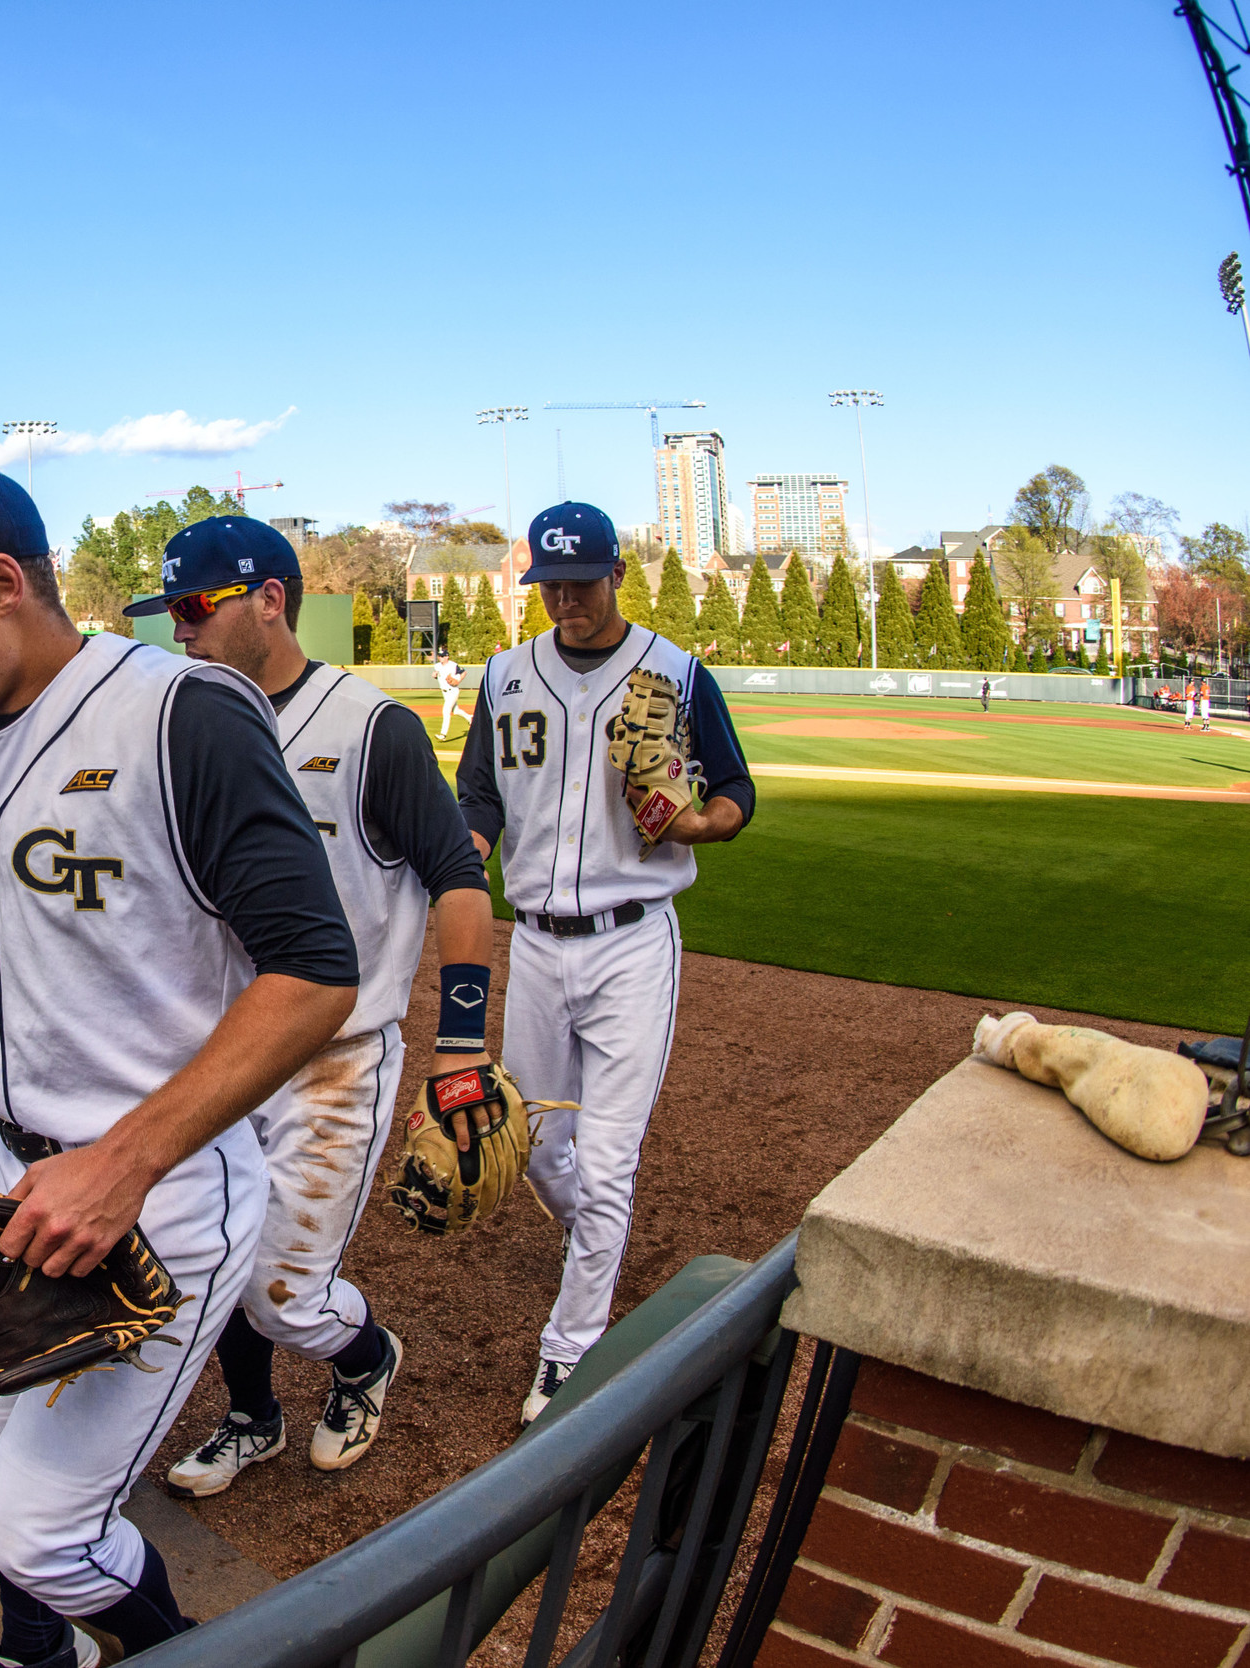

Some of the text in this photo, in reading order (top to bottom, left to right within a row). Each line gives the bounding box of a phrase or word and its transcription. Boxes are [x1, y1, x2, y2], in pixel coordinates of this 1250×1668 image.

[540, 527, 581, 555] GT
[745, 672, 778, 684] ACC
[496, 710, 548, 770] 13
[304, 757, 339, 770] ACC
[64, 769, 115, 789] ACC
[12, 827, 124, 912] GT
